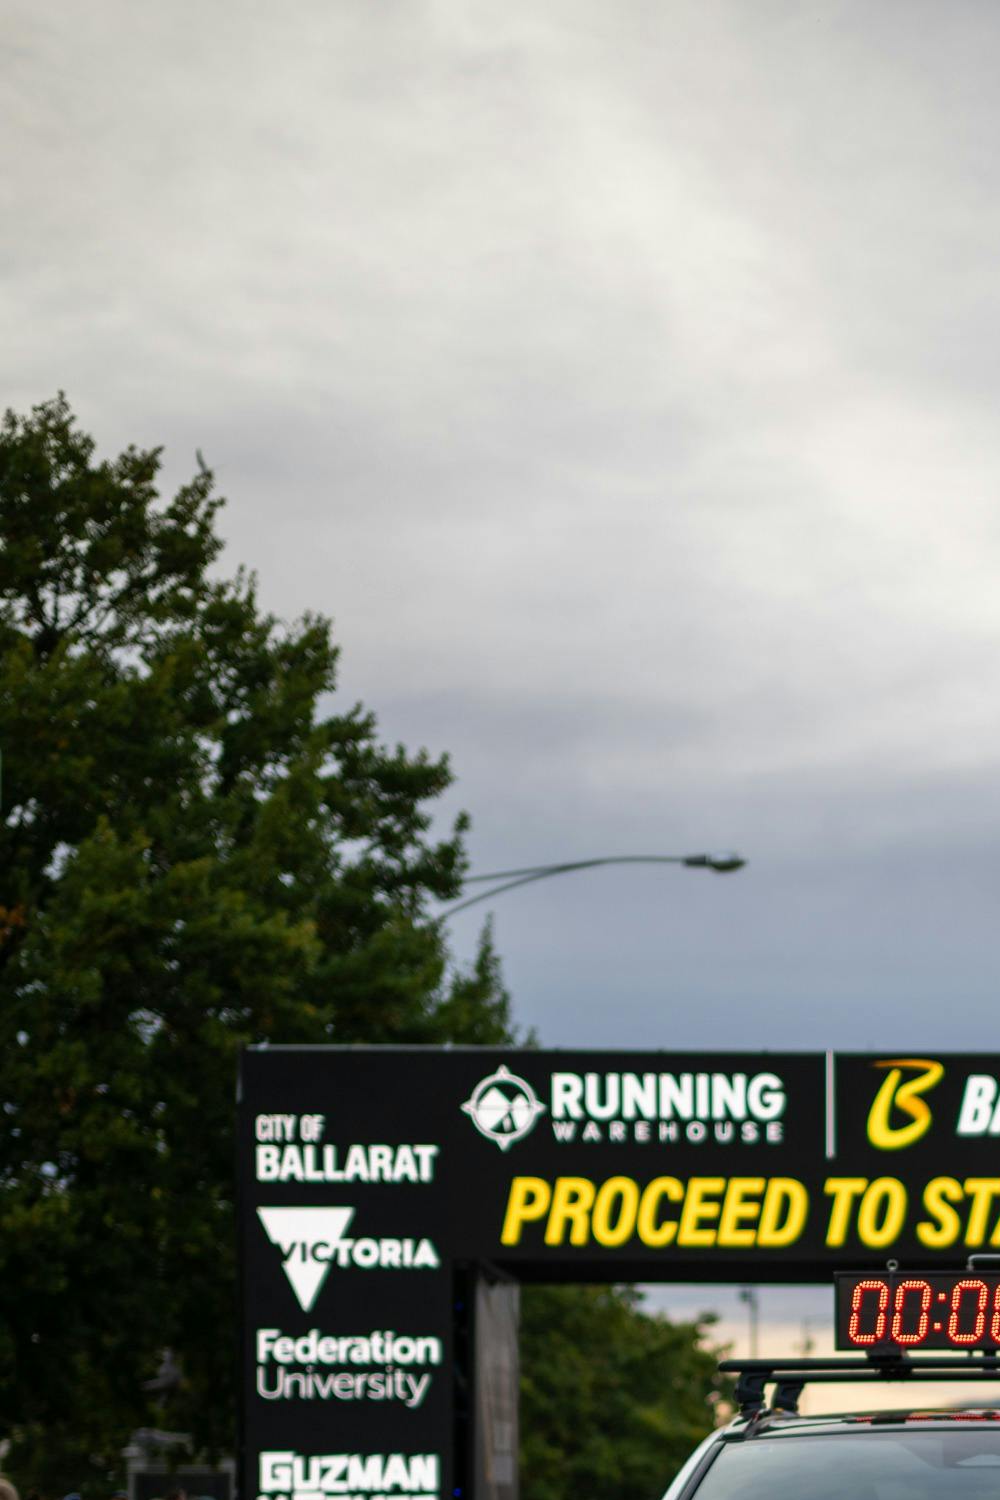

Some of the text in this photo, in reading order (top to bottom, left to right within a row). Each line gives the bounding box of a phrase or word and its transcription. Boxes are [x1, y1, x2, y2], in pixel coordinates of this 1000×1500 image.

[551, 1072, 786, 1121] RUNNING
[256, 1113, 325, 1142] CITY OF
[552, 1121, 783, 1143] WAREHOUSE
[255, 1144, 439, 1182] BALLARAT
[500, 1176, 808, 1248] PROCEED
[824, 1176, 908, 1248] TO
[274, 1238, 440, 1268] VICTORIA
[256, 1328, 441, 1364] Federation
[256, 1365, 430, 1408] University
[259, 1450, 439, 1493] GUZMAN
